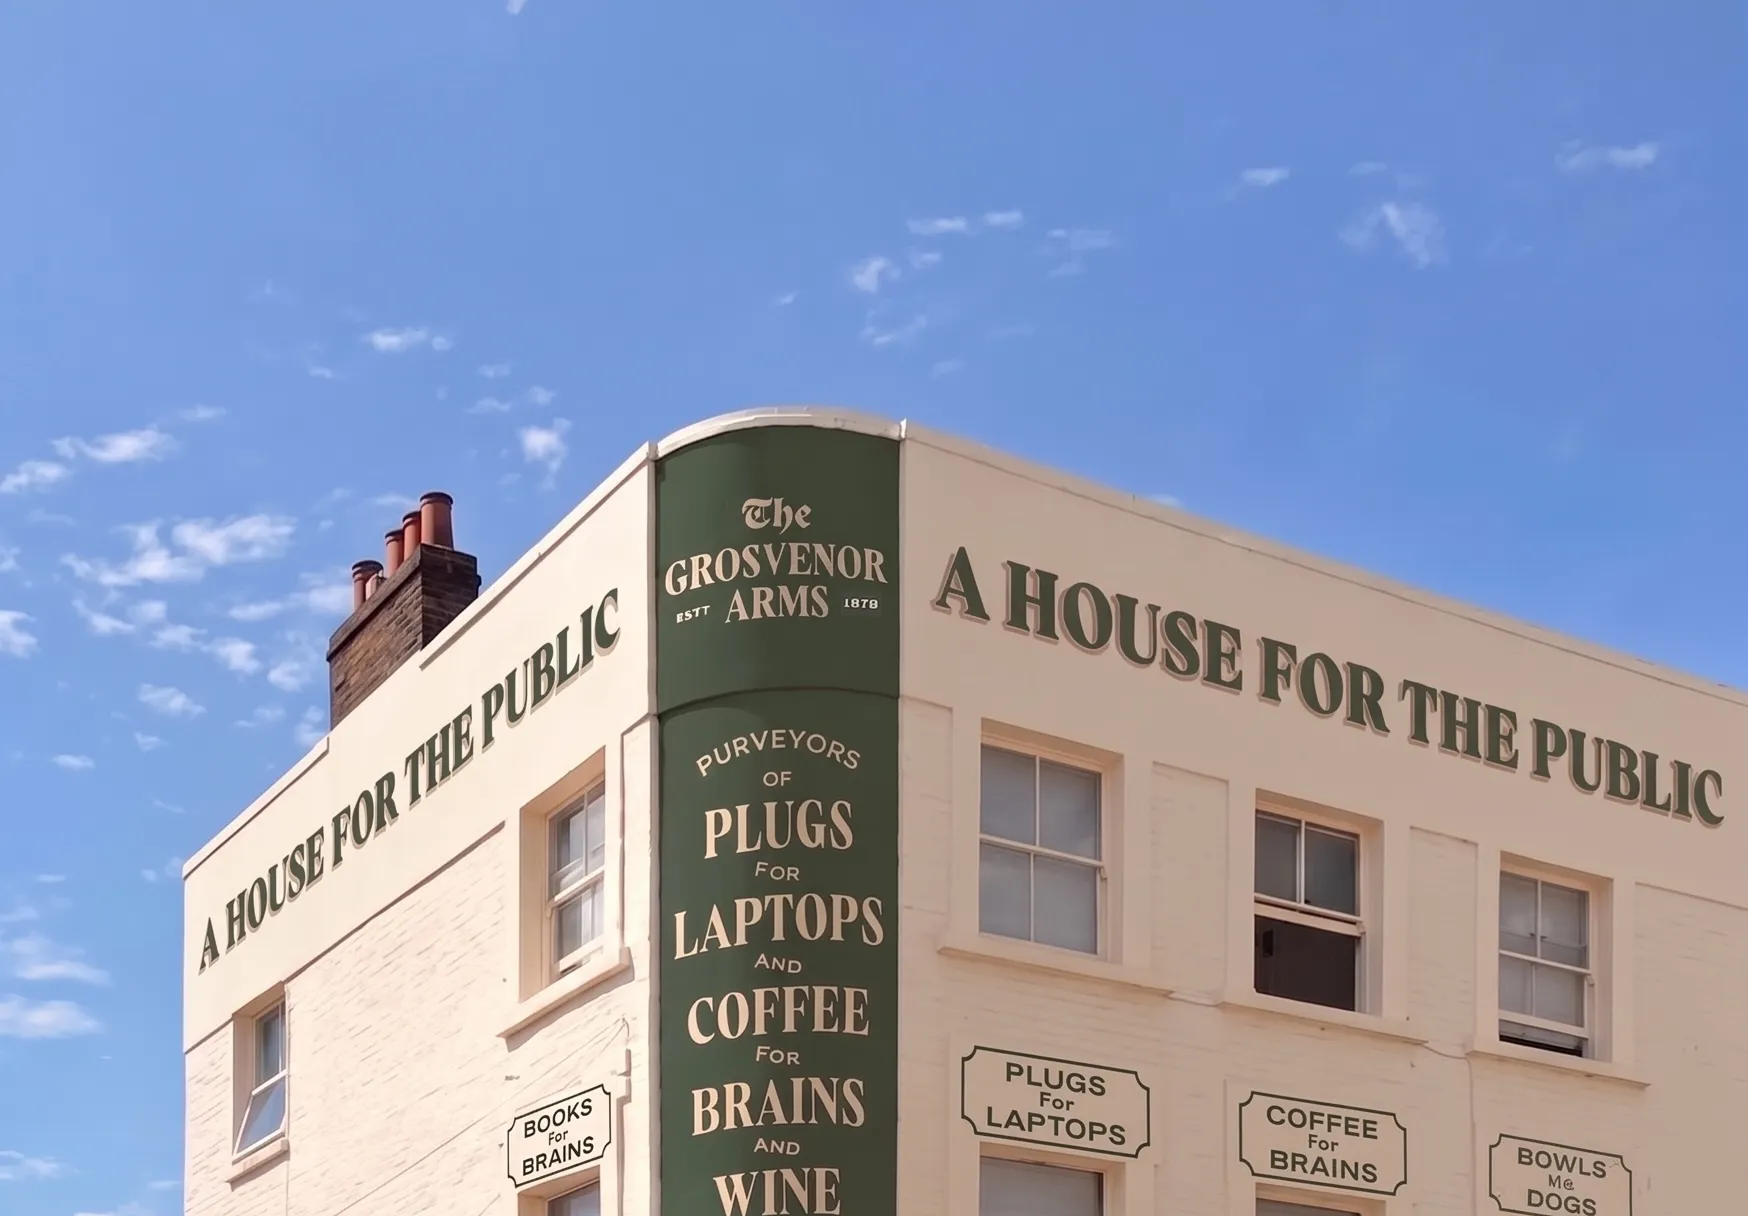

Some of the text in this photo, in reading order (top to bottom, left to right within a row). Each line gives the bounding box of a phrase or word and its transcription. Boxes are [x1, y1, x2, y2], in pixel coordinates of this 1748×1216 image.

[741, 497, 812, 534] The
[664, 543, 888, 598] GROSVENOR
[725, 585, 829, 623] ARMS
[844, 598, 878, 609] 1878
[930, 546, 1725, 828] A HOUSE FOR THE PUBLIC
[696, 729, 861, 777] PURVEYORS
[198, 587, 621, 975] A HOUSE FOR THE PUBLIC
[763, 771, 792, 787] OF
[704, 799, 853, 859] PLUGS
[673, 892, 884, 961] LAPTOPS
[754, 953, 802, 974] AND
[687, 985, 870, 1045] COFFEE
[1005, 1062, 1106, 1096] PLUGS
[524, 1098, 592, 1138] BOOKS
[691, 1077, 865, 1137] BRAINS
[986, 1106, 1126, 1146] LAPTOPS
[1266, 1105, 1378, 1140] COFFEE
[522, 1136, 594, 1176] BRAINS
[754, 1137, 801, 1156] AND
[1269, 1149, 1378, 1183] BRAINS
[1518, 1147, 1606, 1179] BOWLS
[1527, 1189, 1597, 1216] DOGS
